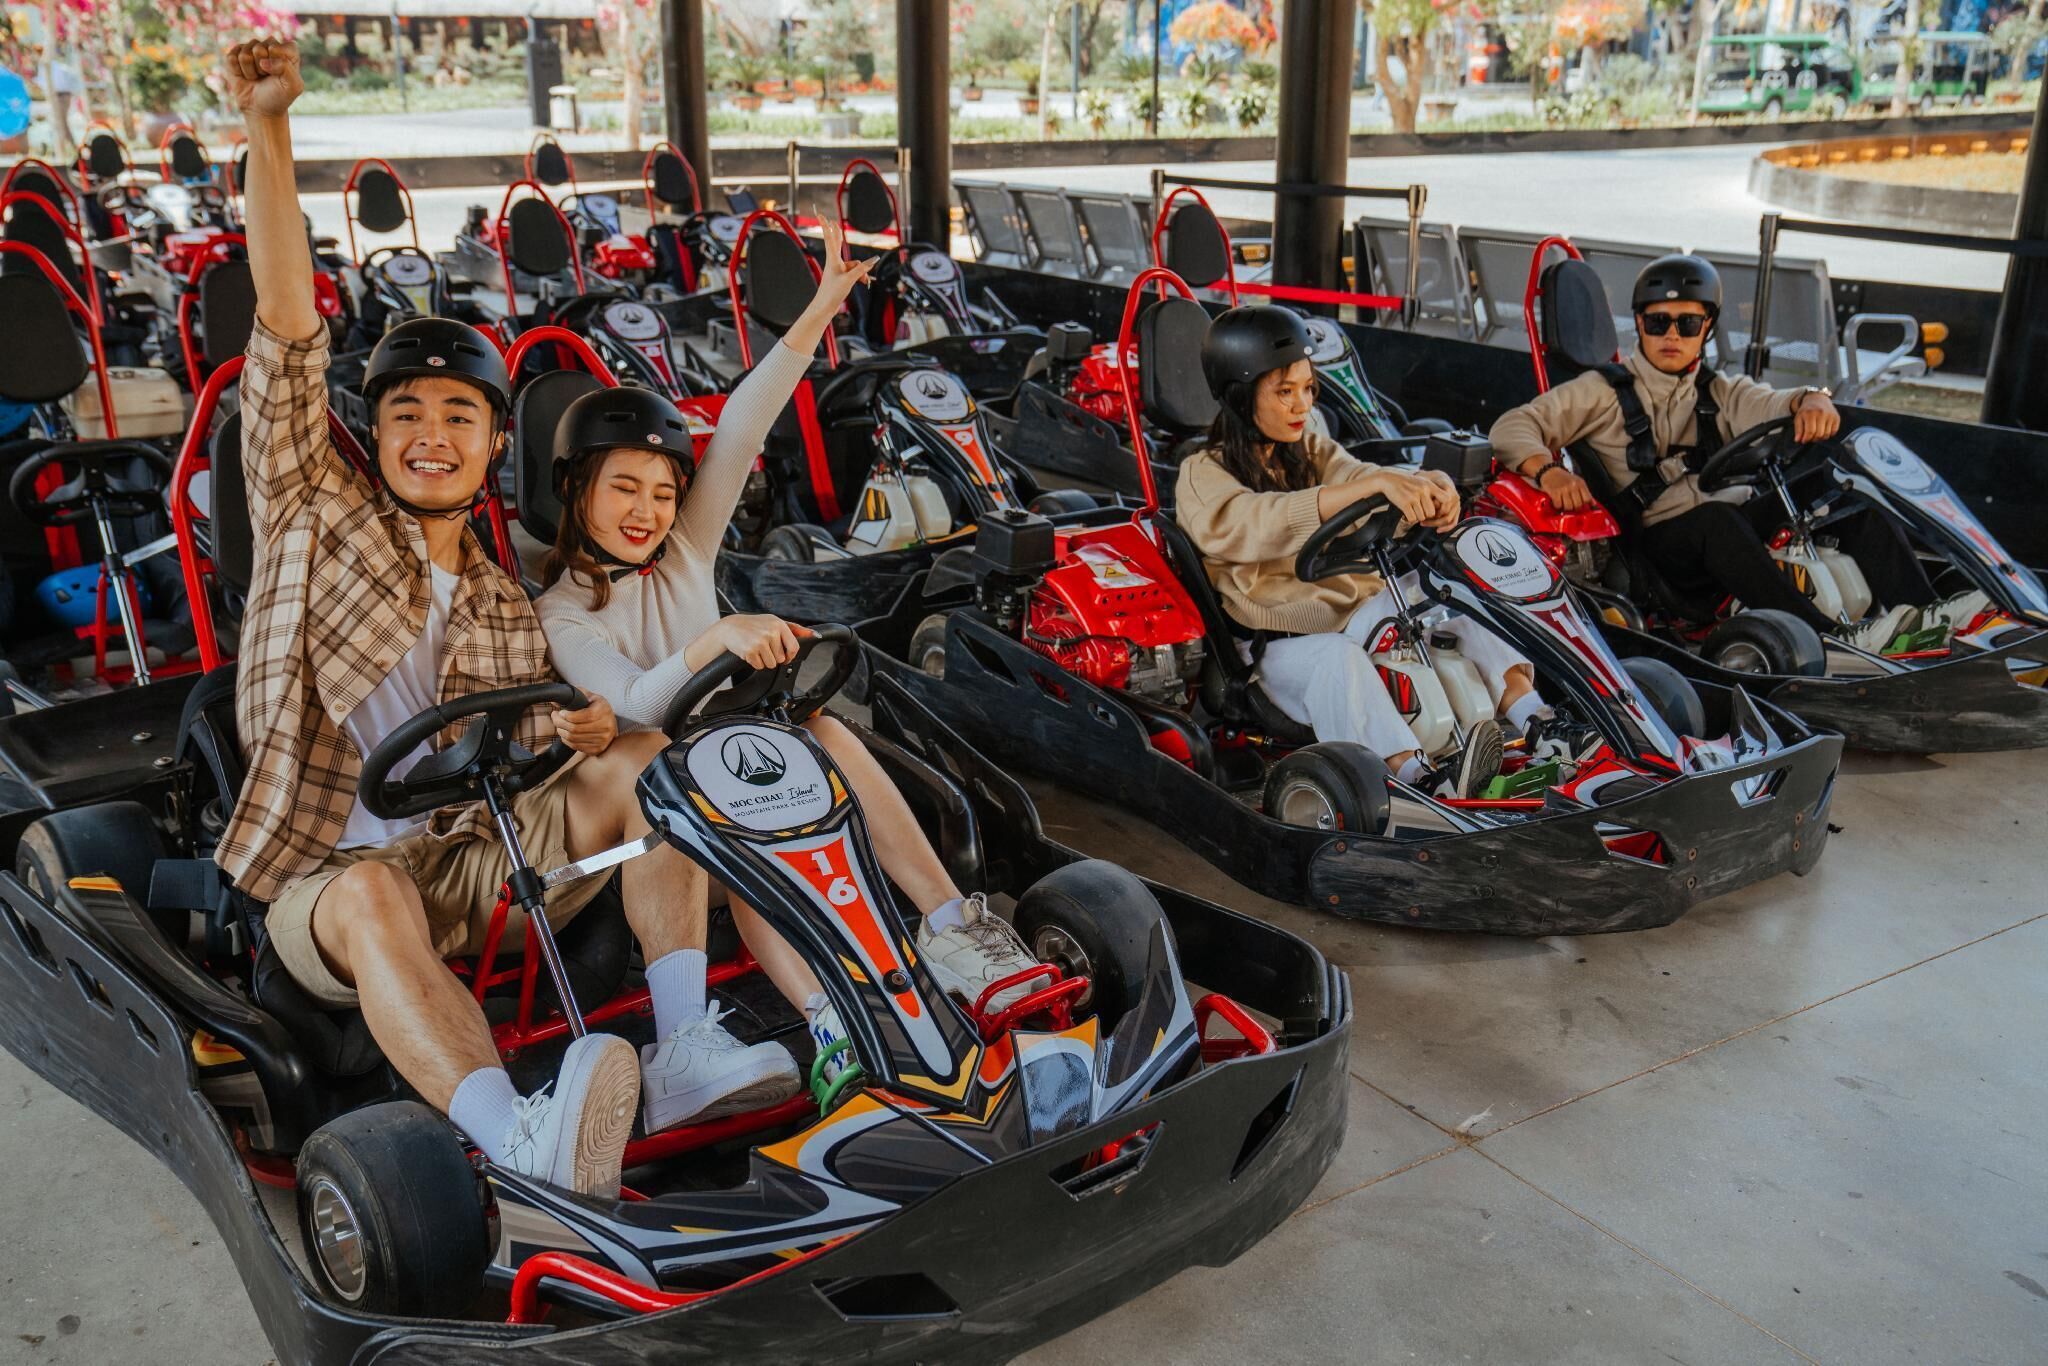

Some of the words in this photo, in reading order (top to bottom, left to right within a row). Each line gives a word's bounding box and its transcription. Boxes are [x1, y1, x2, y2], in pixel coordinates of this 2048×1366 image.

[954, 430, 973, 446] 9
[1551, 610, 1580, 638] 1
[734, 806, 771, 817] MOUNTAIN
[772, 803, 789, 811] PARK
[797, 796, 822, 805] RESORT
